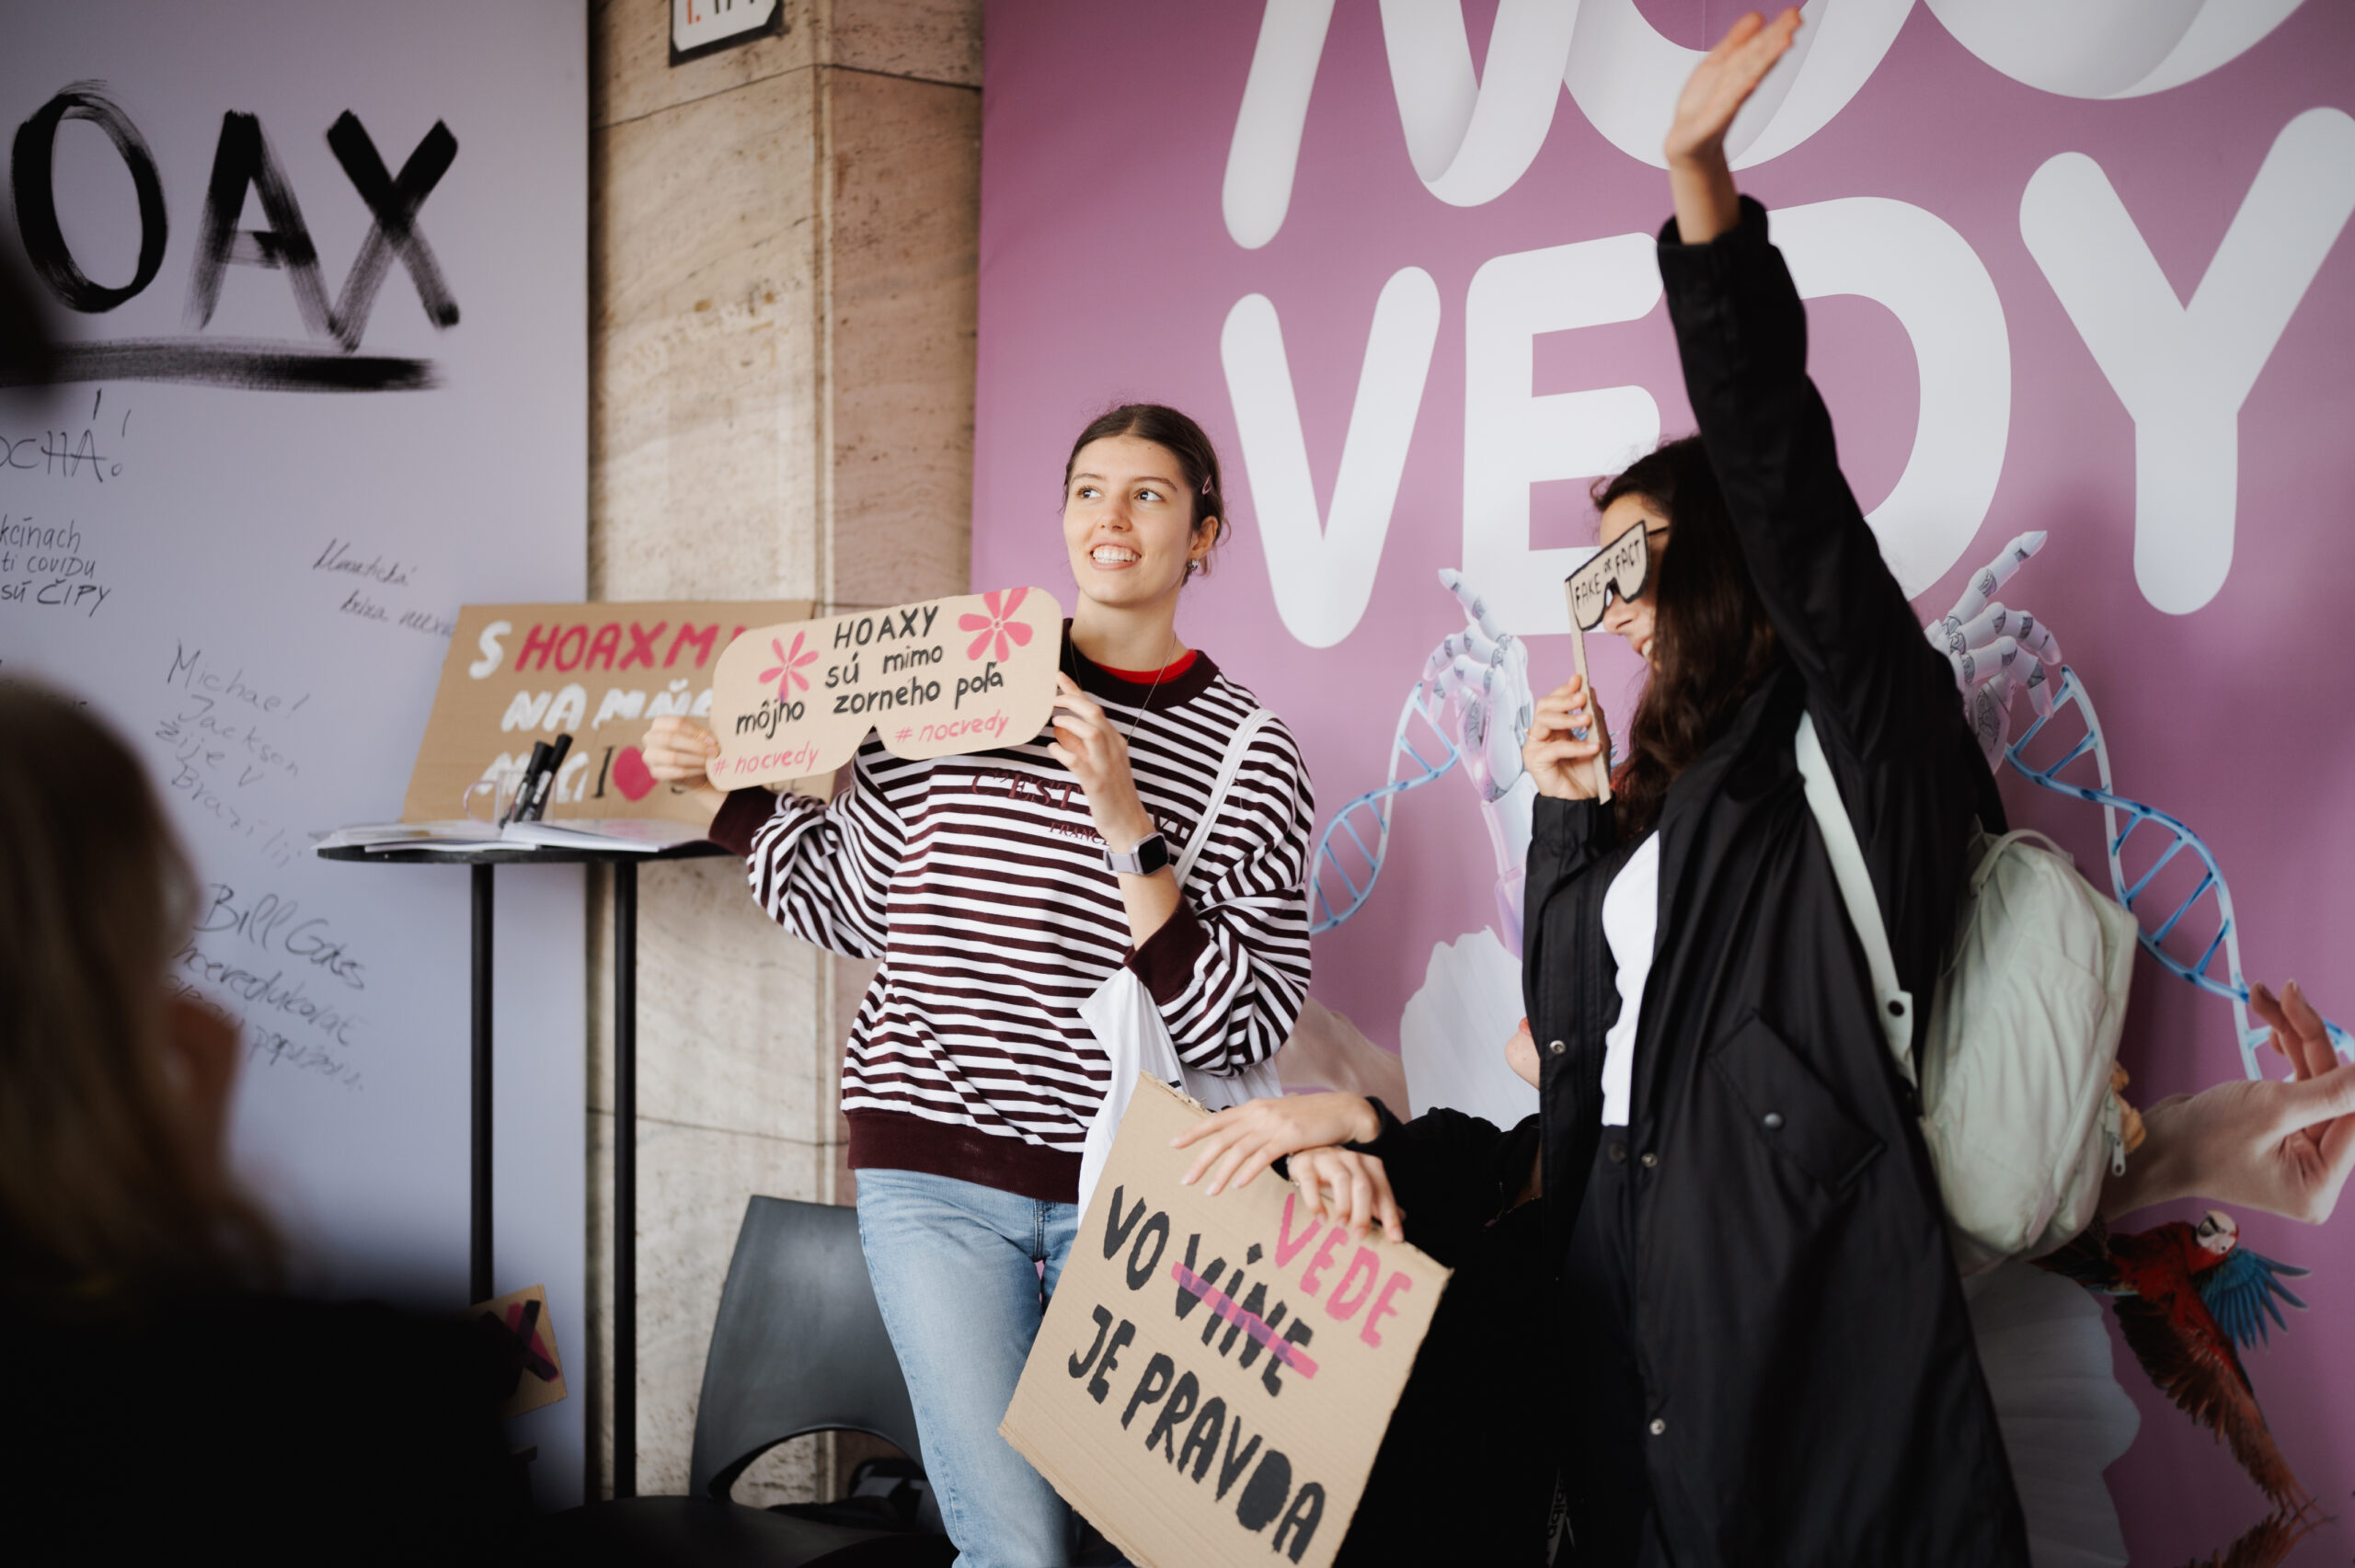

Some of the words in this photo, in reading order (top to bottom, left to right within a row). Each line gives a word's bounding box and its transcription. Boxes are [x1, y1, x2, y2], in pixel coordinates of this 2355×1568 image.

[11, 79, 459, 352] OAX
[1221, 106, 2355, 649] VEDY
[37, 578, 111, 618] ČIPY
[1575, 573, 1601, 610] FAKE
[1615, 540, 1639, 577] FACT
[468, 620, 512, 680] S
[833, 605, 938, 649] HOAXY
[825, 651, 858, 688] sú
[883, 646, 943, 673] mimo
[178, 693, 299, 777] Jackson
[500, 682, 587, 732] NA
[736, 692, 805, 739] môjho
[193, 883, 298, 950] Bill
[1103, 1185, 1169, 1290] VO
[1275, 1193, 1413, 1348] VEDE
[1068, 1304, 1136, 1404] JE
[1120, 1352, 1326, 1564] PRAVDA
